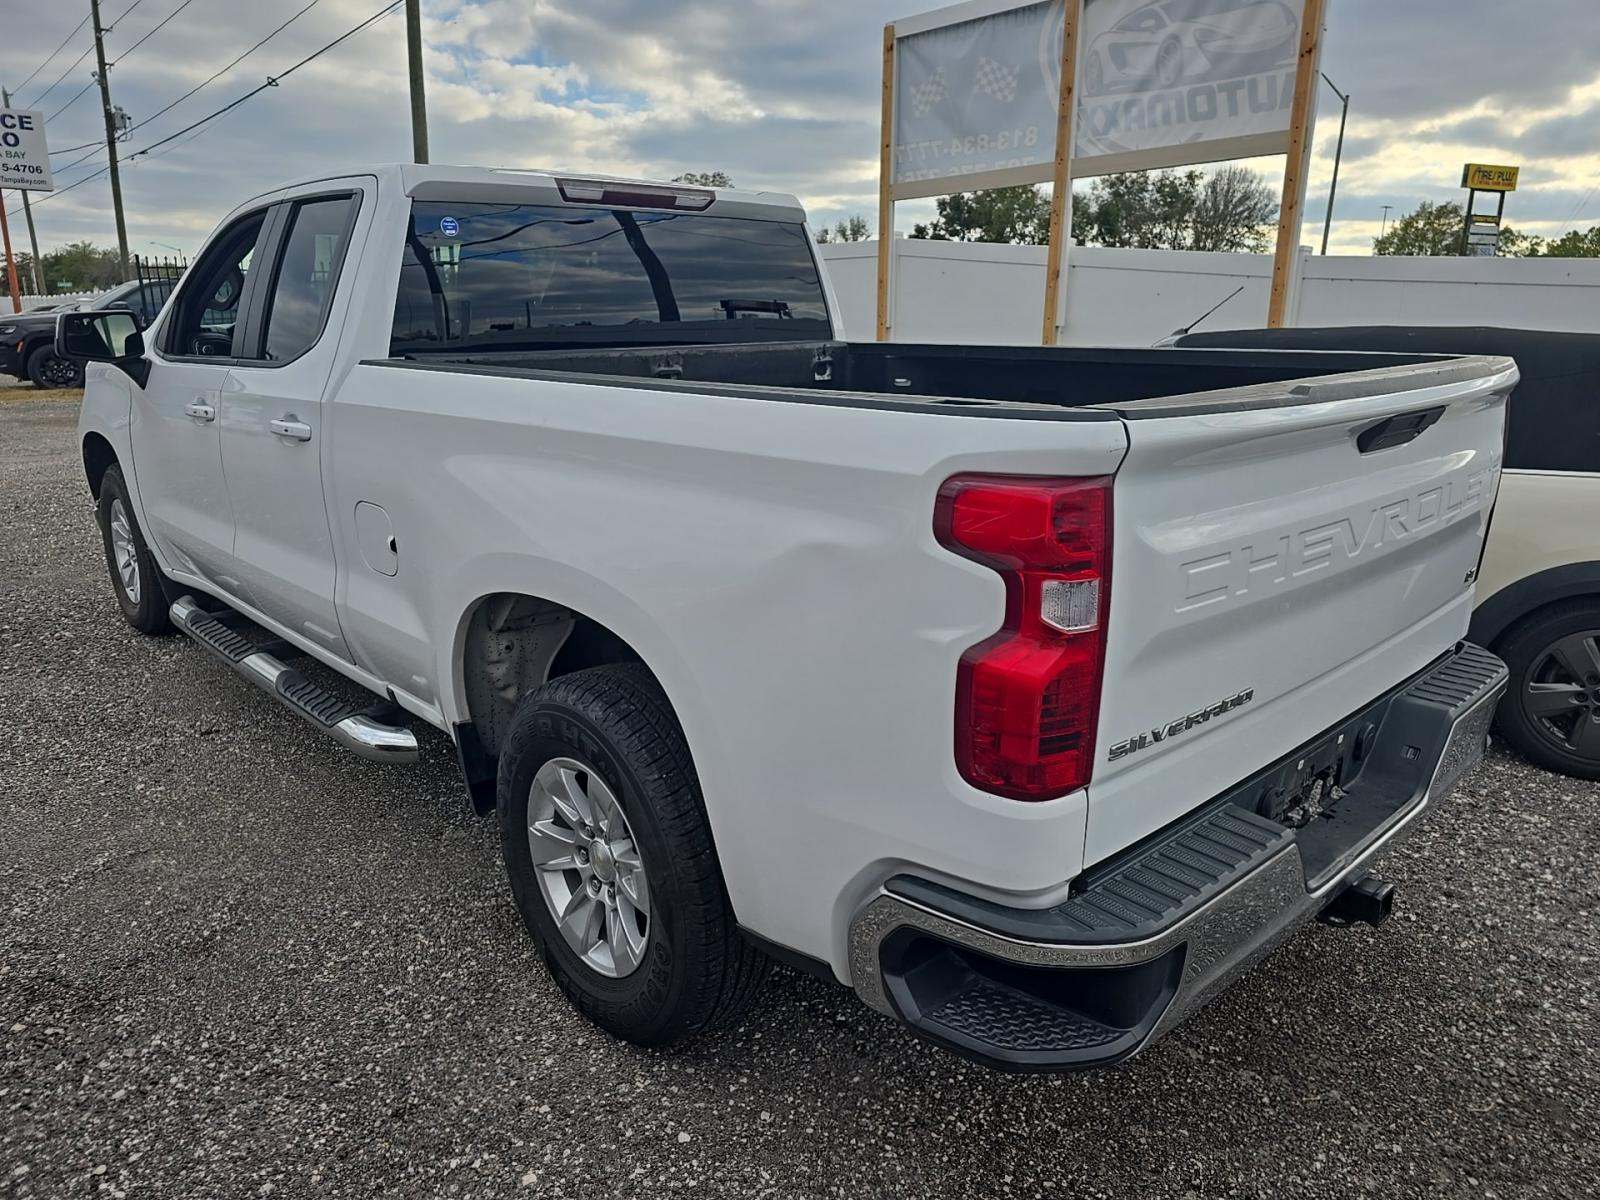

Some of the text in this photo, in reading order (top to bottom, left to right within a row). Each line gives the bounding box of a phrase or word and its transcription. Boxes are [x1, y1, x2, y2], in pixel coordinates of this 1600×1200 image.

[0, 132, 20, 147] O
[5, 150, 26, 159] BAY
[2, 163, 43, 174] 5-4706
[1107, 687, 1254, 761] SILVERADO
